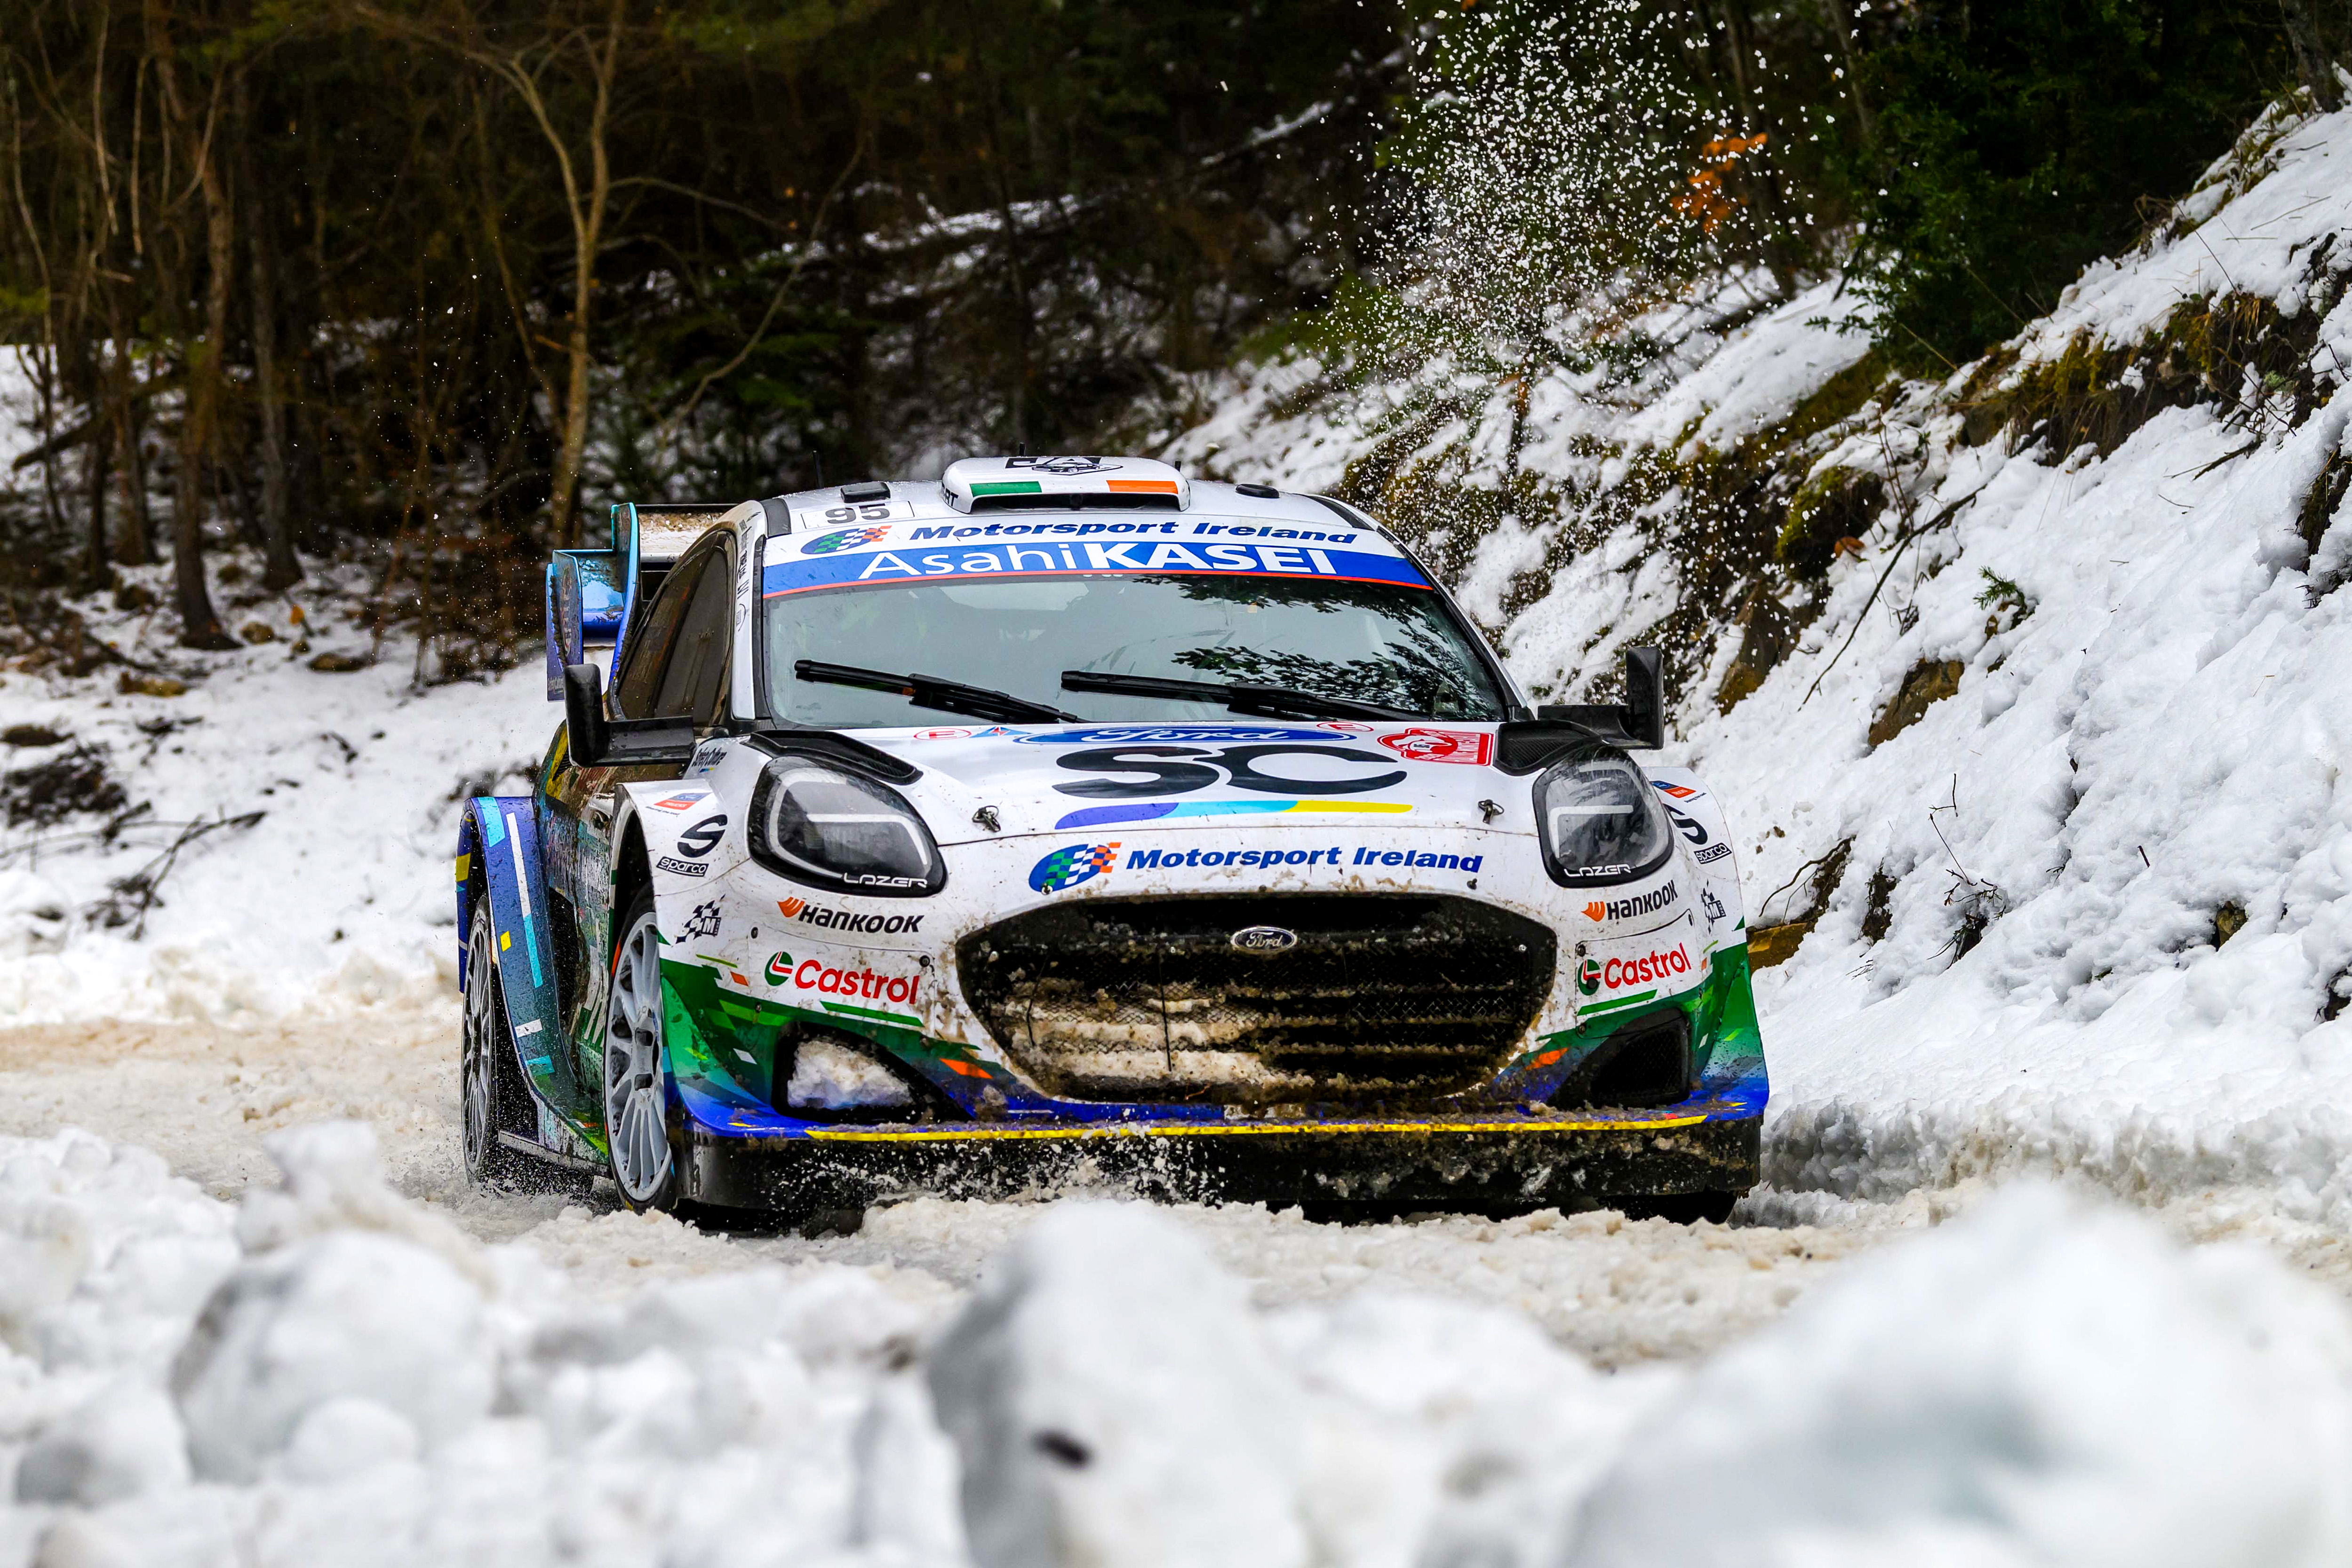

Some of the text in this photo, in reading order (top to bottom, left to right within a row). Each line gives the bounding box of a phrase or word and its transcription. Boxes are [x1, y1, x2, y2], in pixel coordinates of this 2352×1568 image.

[825, 503, 890, 524] 95
[910, 521, 1357, 544] Motorsport Ireland
[858, 542, 1337, 579] AsahiKASEI
[1081, 728, 1290, 742] Ford
[1052, 744, 1407, 798] SC
[1126, 847, 1483, 873] Motorsport Ireland
[1696, 844, 1727, 863] sparco
[661, 858, 706, 873] sparco
[1563, 864, 1631, 877] LAZER
[844, 872, 928, 888] LAZER
[1246, 931, 1284, 947] Ford
[1604, 942, 1691, 989] Castrol
[795, 959, 919, 1004] Castrol
